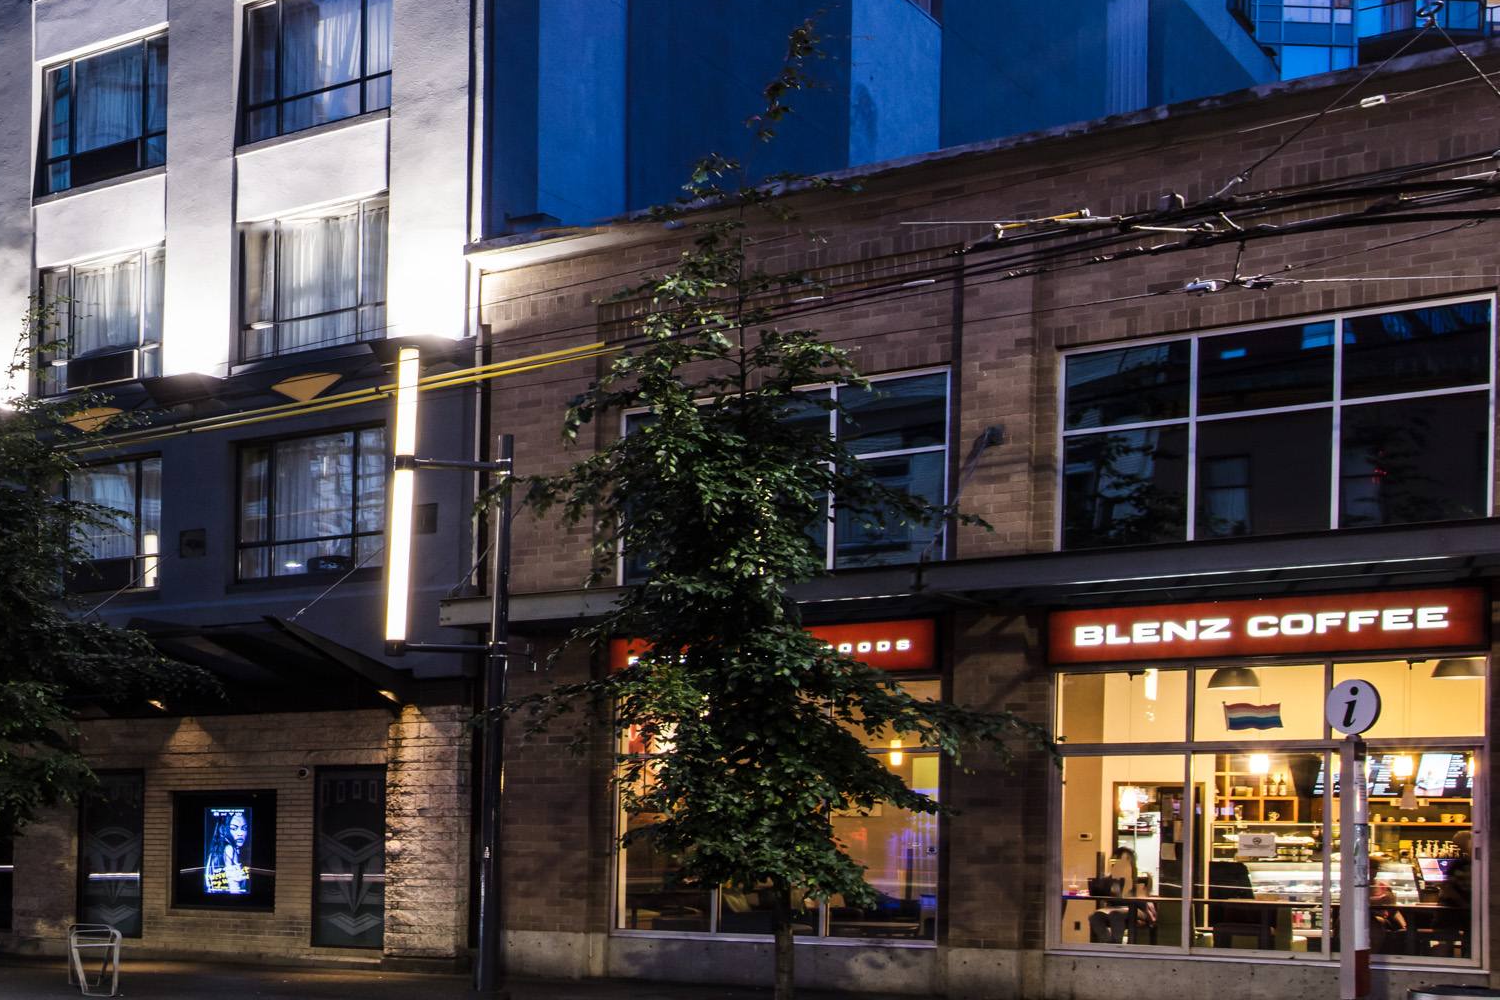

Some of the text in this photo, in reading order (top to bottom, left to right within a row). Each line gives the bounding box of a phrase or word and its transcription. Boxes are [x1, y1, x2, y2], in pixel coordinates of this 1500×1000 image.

[1074, 606, 1449, 647] BLENZ COFFEE
[818, 639, 911, 653] OODS
